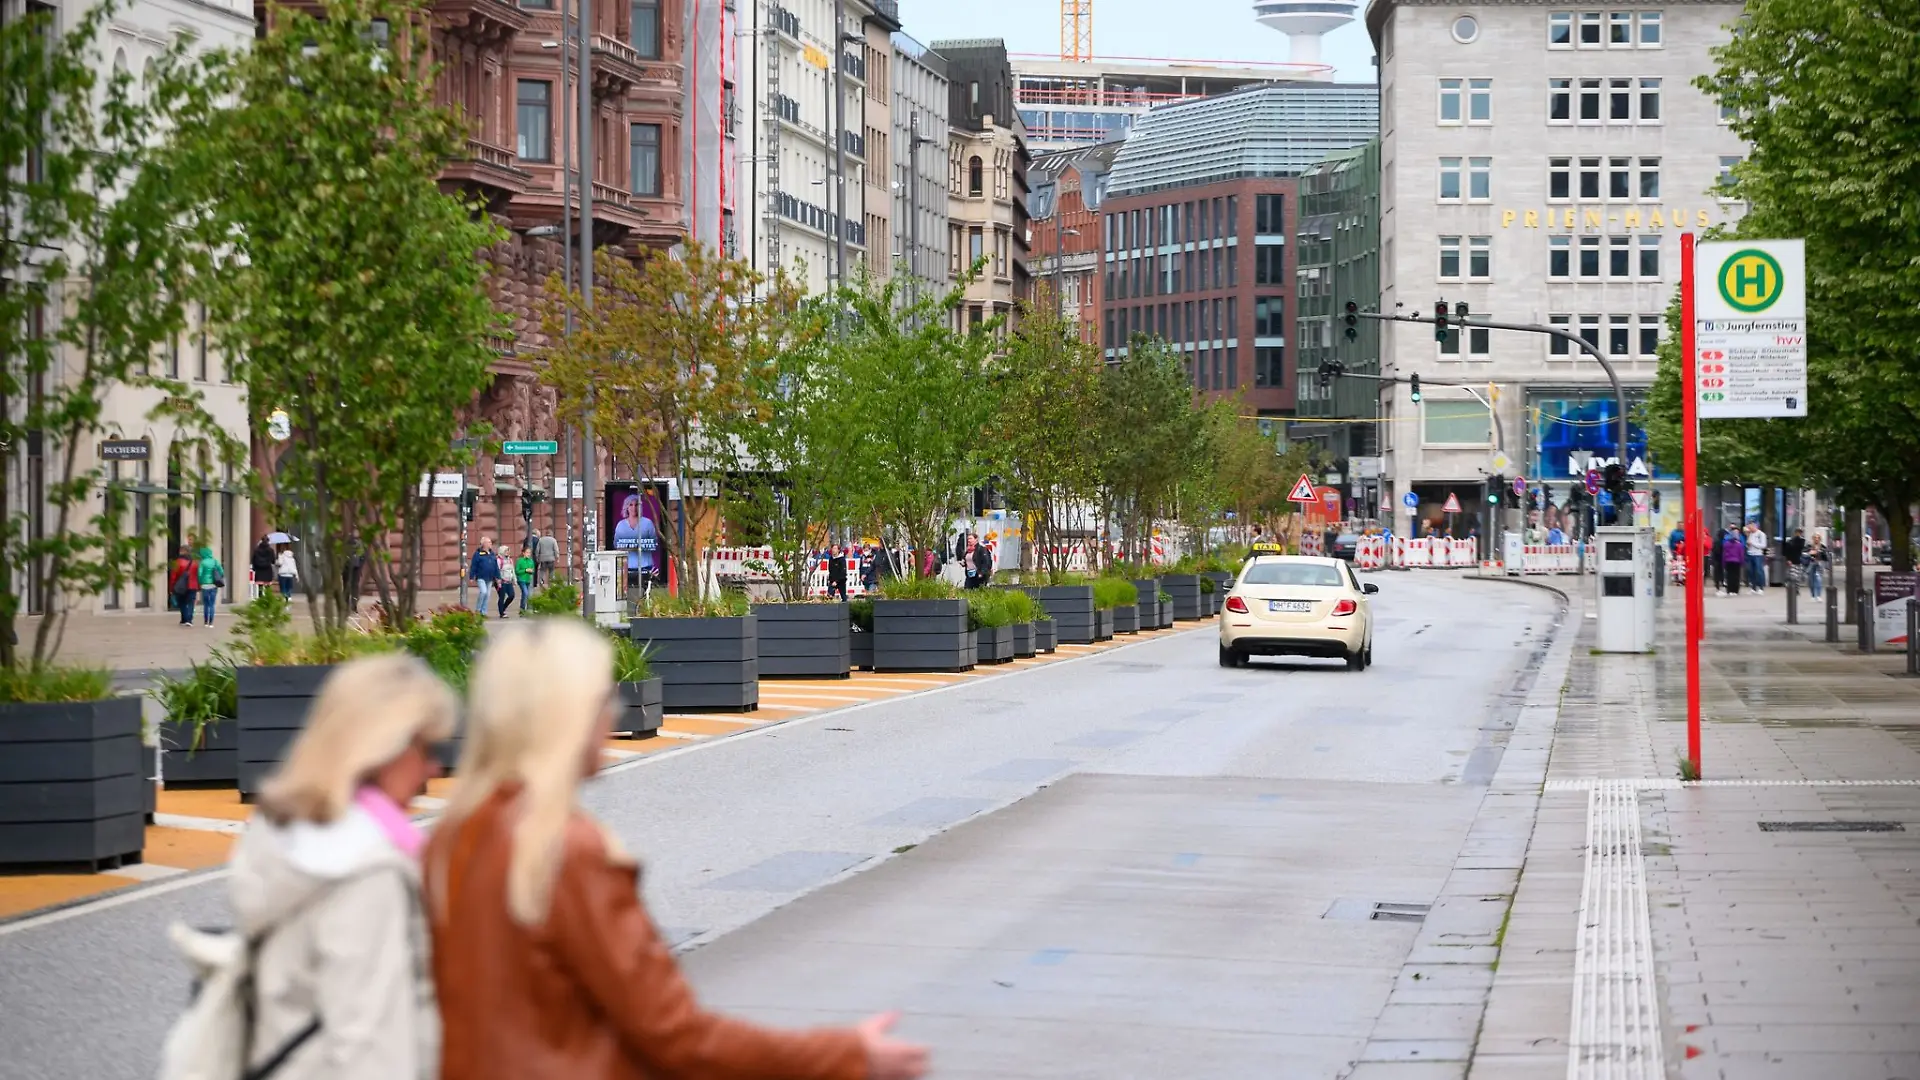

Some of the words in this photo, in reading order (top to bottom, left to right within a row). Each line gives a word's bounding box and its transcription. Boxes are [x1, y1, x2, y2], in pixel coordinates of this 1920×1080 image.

[1502, 208, 1710, 228] PRIEN-HAUS
[1736, 264, 1766, 298] H
[1727, 320, 1798, 334] Jungfernstieg
[1776, 335, 1802, 345] hvv
[103, 446, 147, 454] BUCHERER
